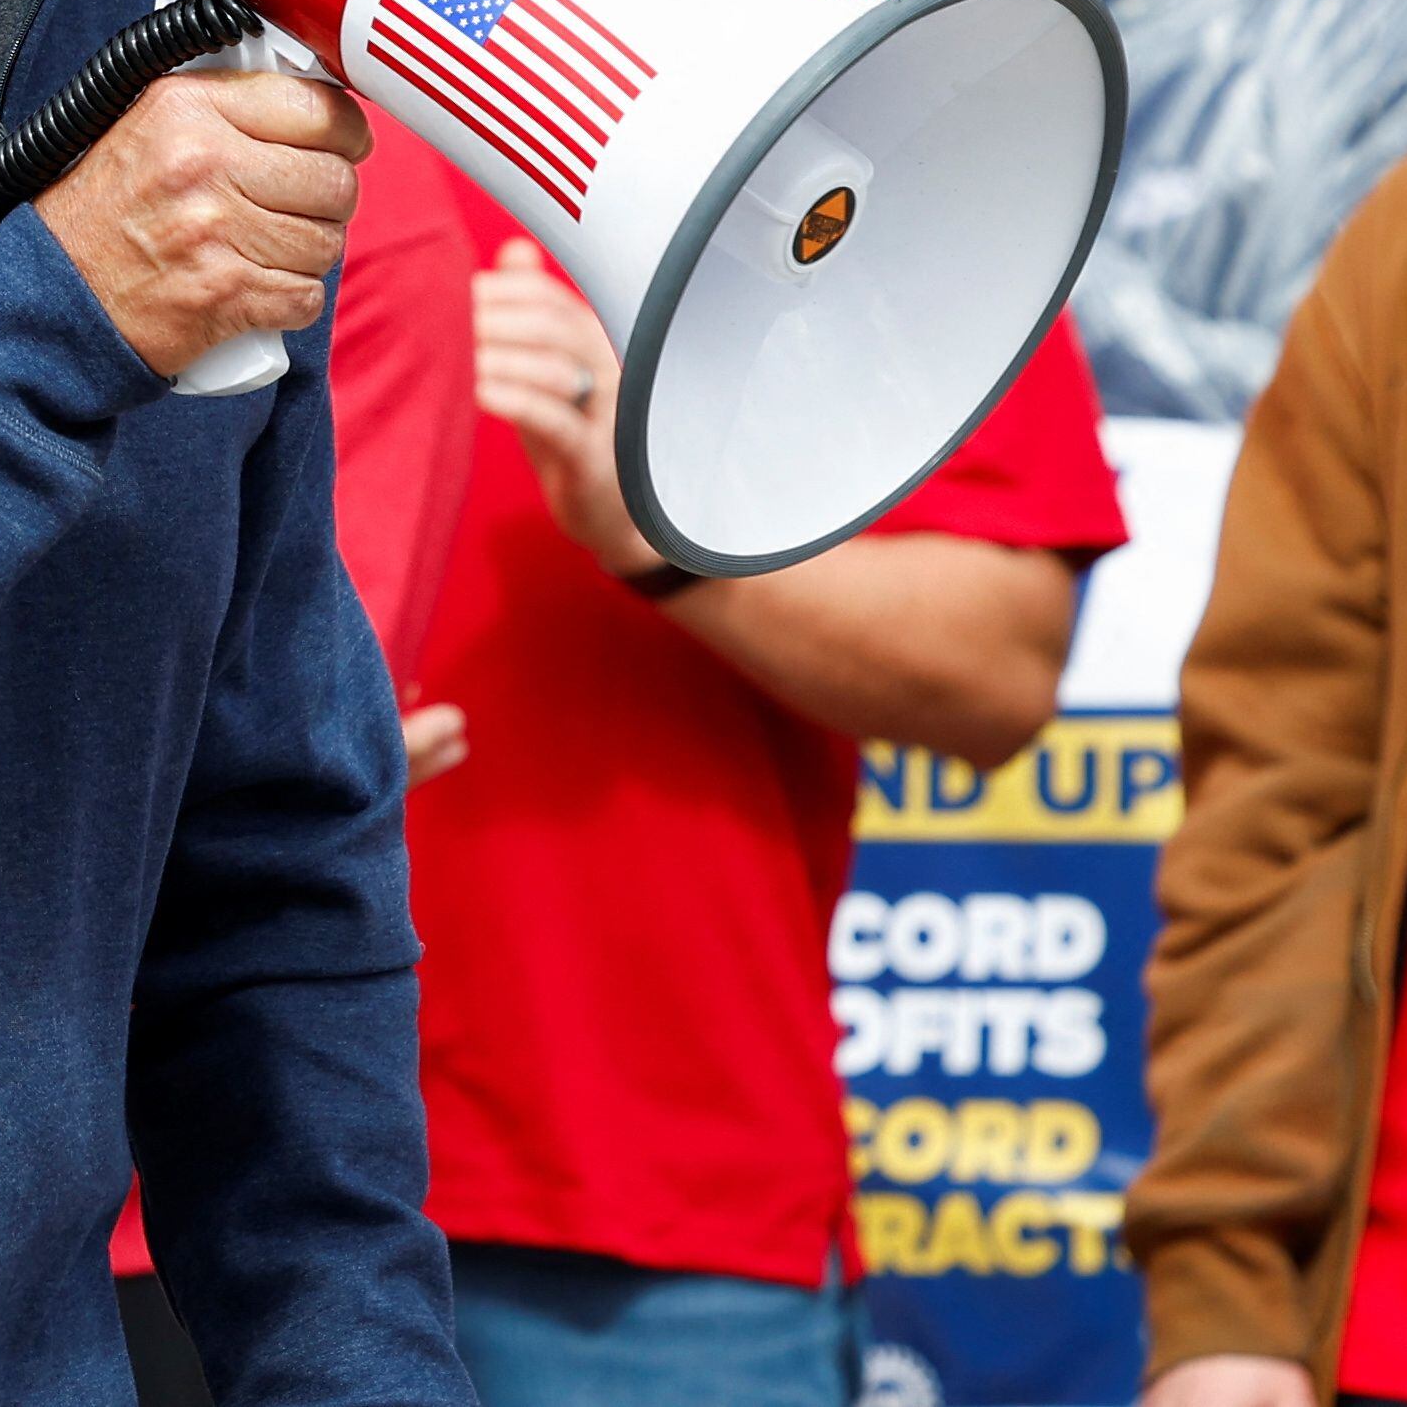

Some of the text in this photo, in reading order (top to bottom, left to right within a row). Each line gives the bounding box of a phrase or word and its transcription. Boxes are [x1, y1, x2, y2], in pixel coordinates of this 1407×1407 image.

[857, 743, 1182, 815] ND UP
[827, 890, 1107, 983] CORD
[828, 985, 1107, 1078] OFITS
[843, 1096, 1101, 1185] CORD
[849, 1190, 1136, 1277] RACT
